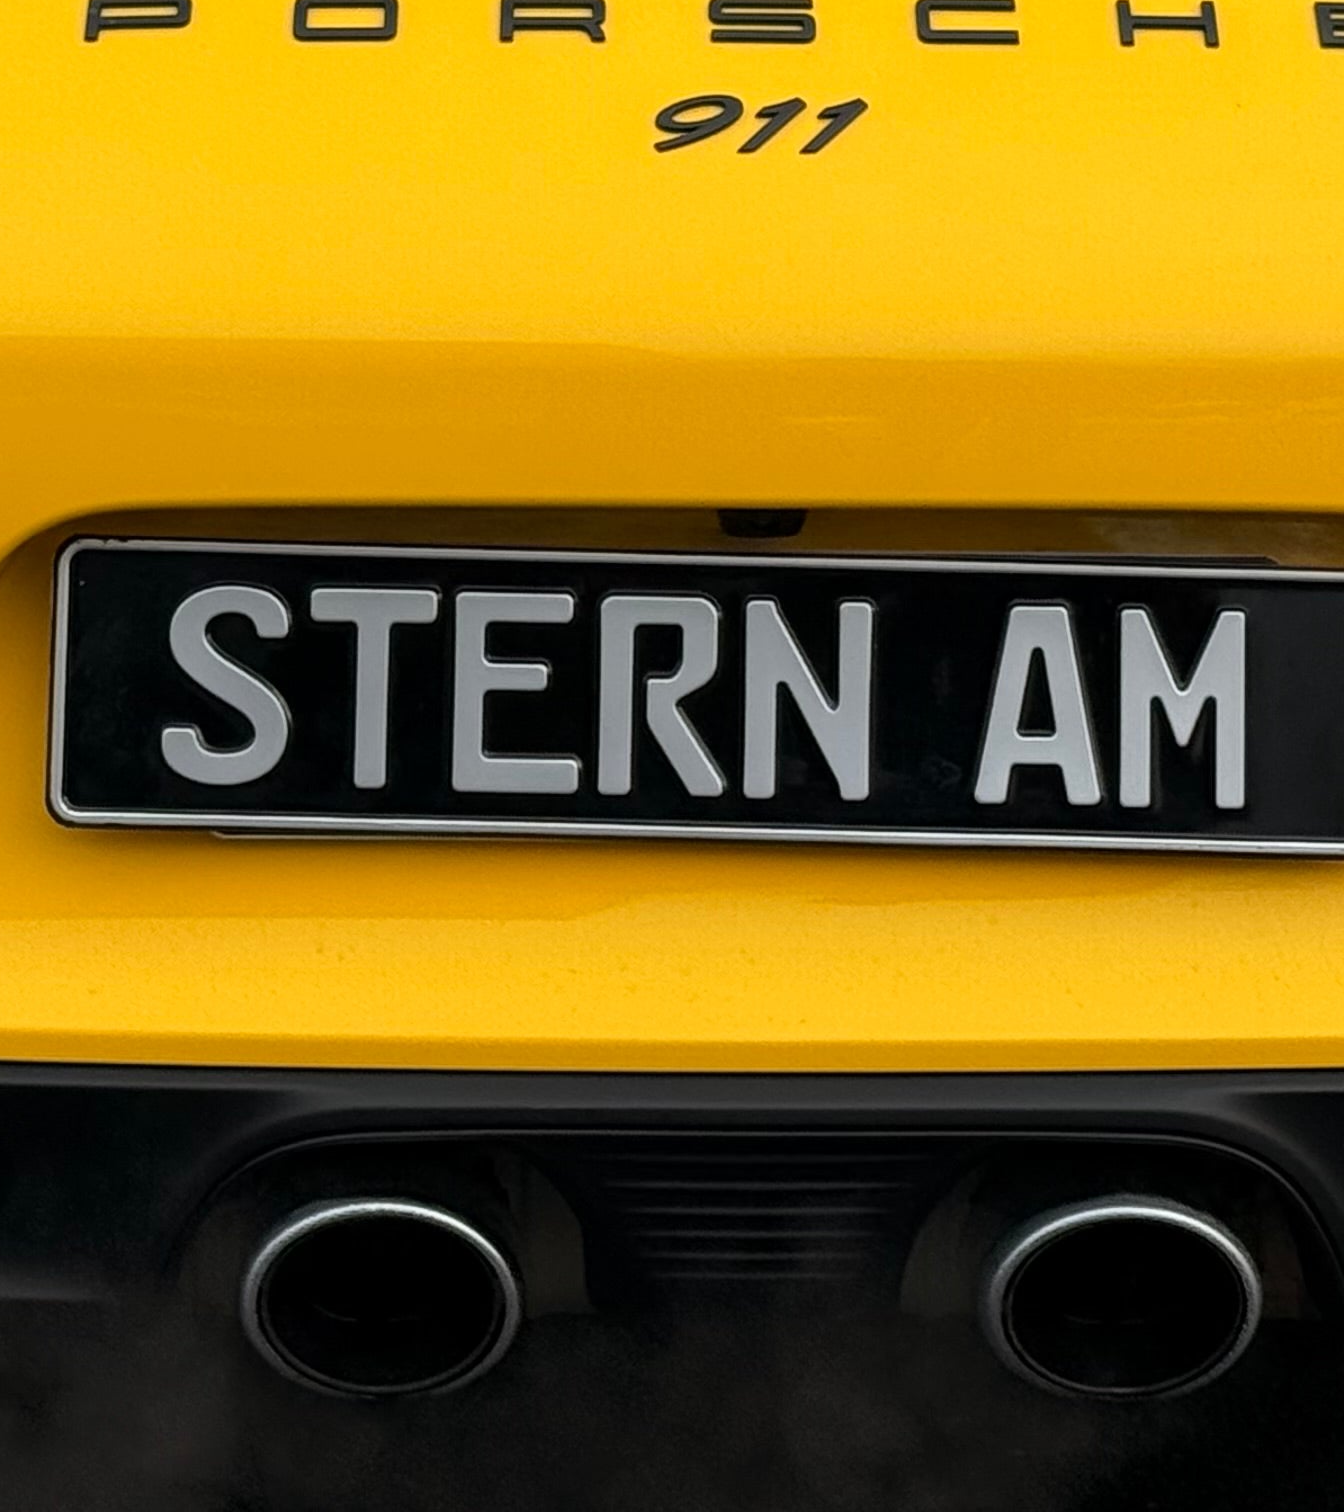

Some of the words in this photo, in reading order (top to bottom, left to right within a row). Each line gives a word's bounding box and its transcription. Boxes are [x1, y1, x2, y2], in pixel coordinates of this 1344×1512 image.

[654, 94, 869, 155] 911
[161, 585, 875, 801] STERN
[973, 605, 1247, 810] AM
